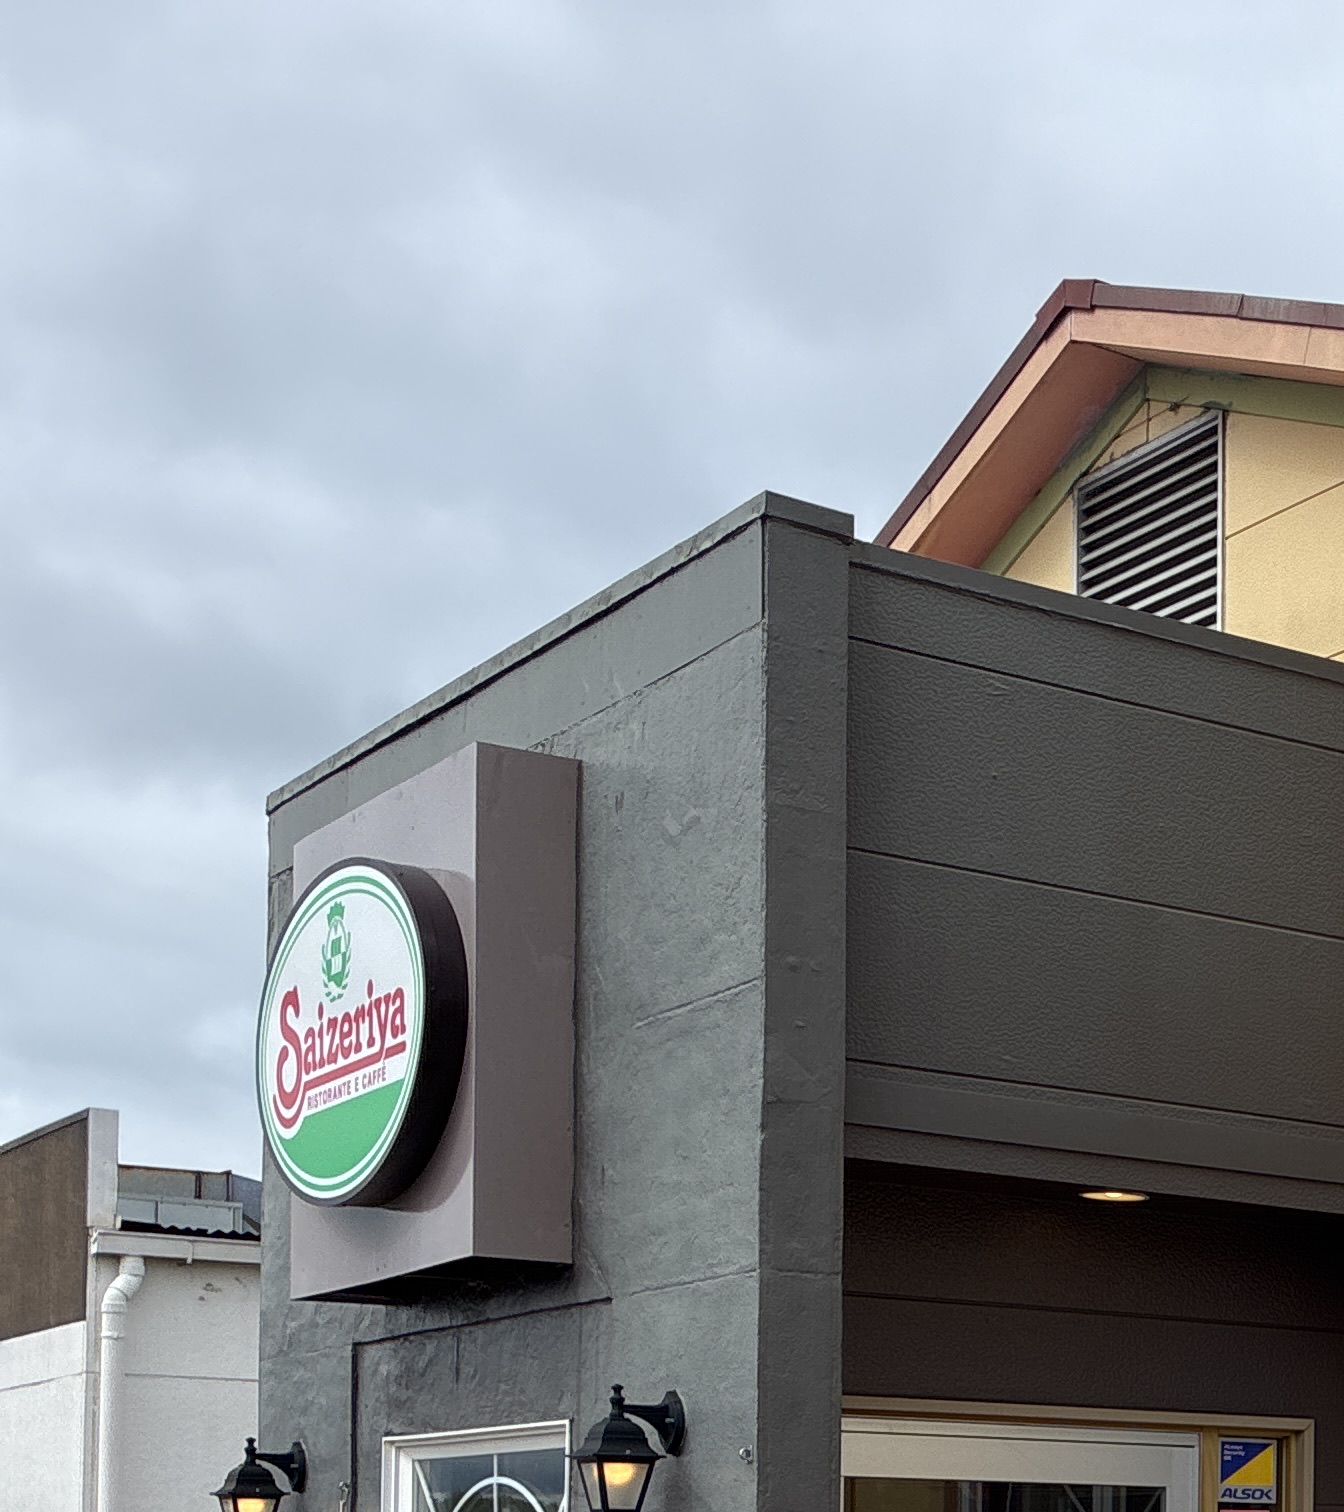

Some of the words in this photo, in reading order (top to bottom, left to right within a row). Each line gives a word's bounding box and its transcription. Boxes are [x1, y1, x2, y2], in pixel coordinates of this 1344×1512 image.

[275, 979, 406, 1113] Saizeriya
[307, 1080, 351, 1110] RISTORANTE
[354, 1076, 359, 1092] E
[1221, 1487, 1273, 1500] ALSOK
